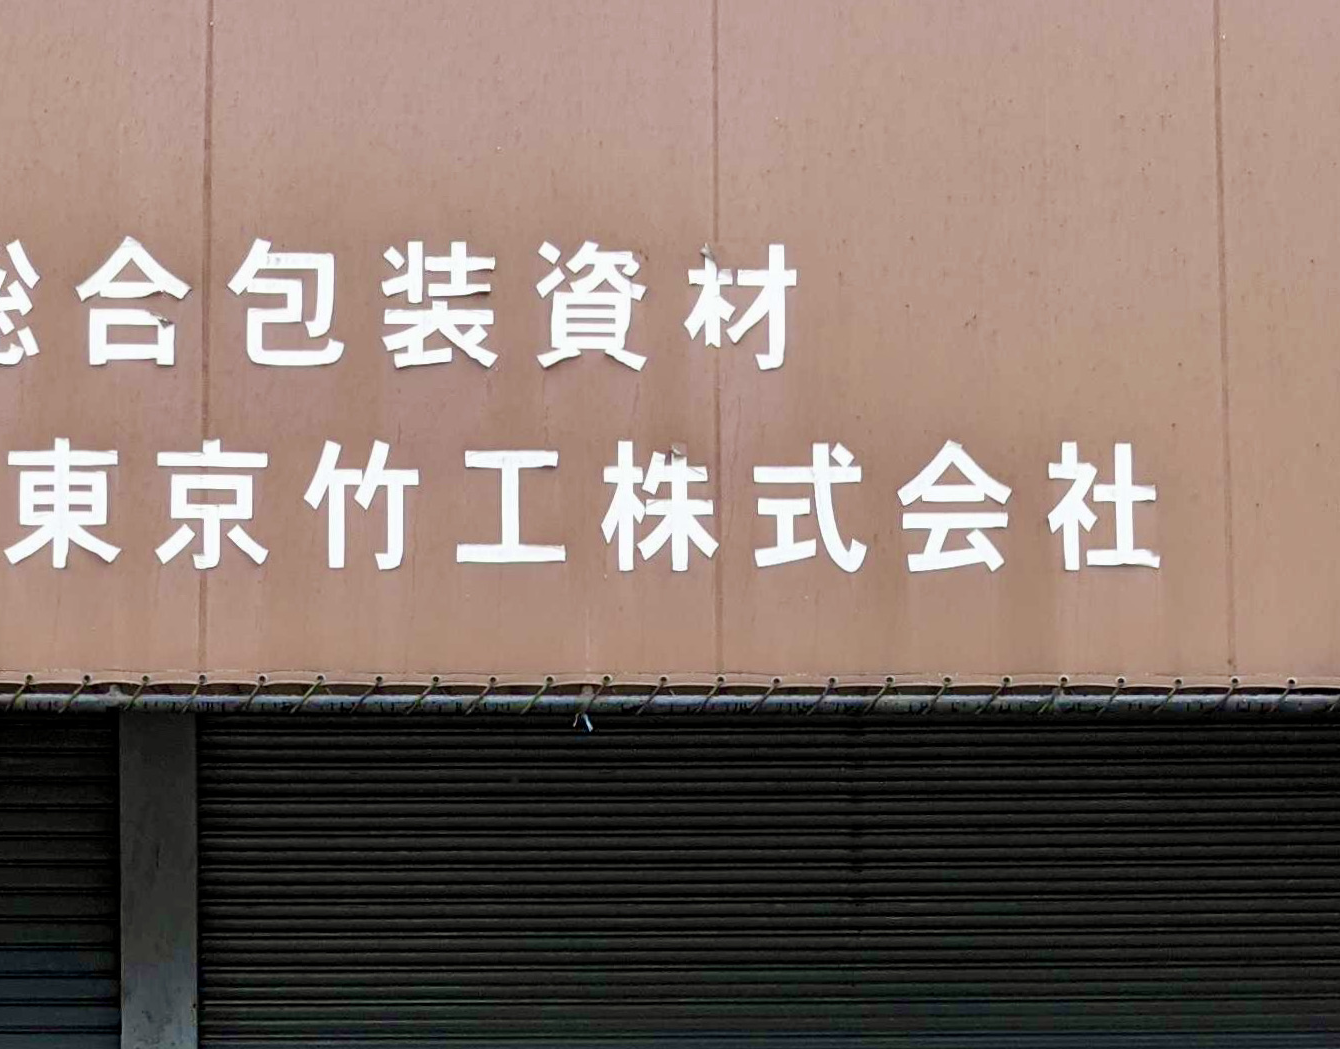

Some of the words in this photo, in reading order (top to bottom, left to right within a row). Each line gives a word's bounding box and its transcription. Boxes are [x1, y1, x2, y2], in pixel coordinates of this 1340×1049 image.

[3, 436, 1161, 572] 東京竹工株式会社
